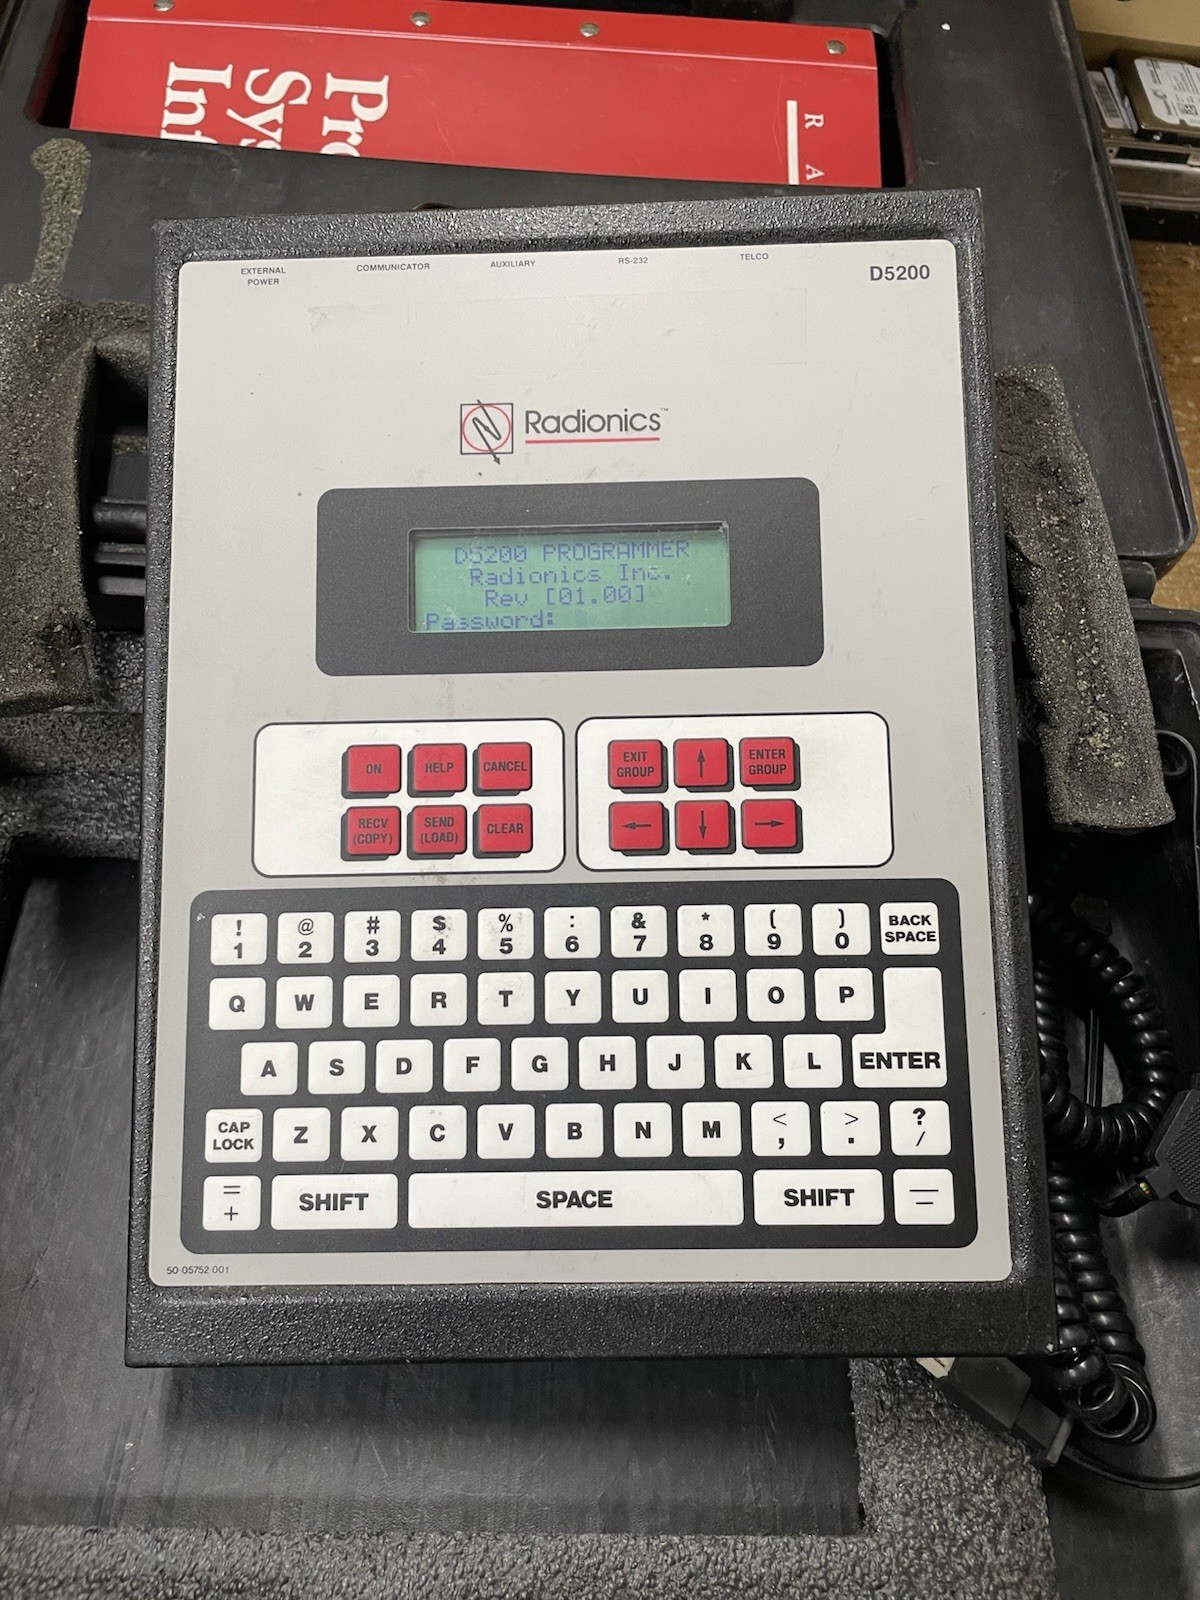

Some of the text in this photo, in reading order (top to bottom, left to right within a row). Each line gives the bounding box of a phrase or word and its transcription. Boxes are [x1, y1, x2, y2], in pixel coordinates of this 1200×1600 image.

[241, 267, 286, 275] EXTERNAL
[357, 263, 429, 271] COMMUNICATOR
[870, 265, 929, 280] D5200
[526, 409, 661, 434] Radionics
[455, 539, 690, 564] D5200 PROGRAMMER
[470, 562, 671, 586] Radionics Inc.
[485, 585, 644, 607] Rev [01.00]
[425, 610, 553, 630] Password:
[624, 752, 647, 761] EXIT
[750, 749, 785, 759] ENTER
[366, 764, 381, 774] ON
[426, 762, 453, 772] HELP
[484, 761, 527, 771] CANCEL
[617, 766, 654, 777] GROUP
[749, 764, 786, 774] GROUP
[359, 818, 387, 828] RECV
[425, 817, 454, 827] SEND
[487, 823, 523, 833] CLEAR
[354, 833, 392, 844] (COPY)
[421, 832, 458, 843] (LOAD)
[237, 920, 241, 936] !
[298, 919, 313, 935] @
[367, 916, 379, 934] #
[433, 916, 446, 932] $
[499, 914, 513, 932] %
[632, 913, 646, 929] &
[889, 915, 931, 925] BACK
[566, 936, 579, 952] 6
[634, 935, 646, 951] 7
[700, 934, 713, 950] 8
[768, 933, 781, 949] 9
[885, 931, 936, 942] SPACE
[234, 943, 242, 958] 1
[299, 942, 312, 958] 2
[366, 940, 379, 956] 3
[433, 939, 446, 954] 4
[500, 938, 513, 954] 5
[295, 994, 314, 1011] W
[365, 993, 378, 1010] E
[432, 992, 446, 1008] R
[499, 991, 513, 1007] T
[566, 990, 580, 1006] Y
[633, 988, 648, 1005] U
[705, 988, 710, 1004] I
[768, 987, 784, 1004] O
[839, 987, 854, 1003] P
[229, 995, 245, 1012] Q
[261, 1060, 277, 1077] A
[330, 1059, 344, 1076] S
[396, 1058, 412, 1075] D
[466, 1057, 479, 1073] F
[532, 1055, 547, 1073] G
[600, 1055, 615, 1071] H
[668, 1054, 680, 1071] J
[736, 1053, 752, 1070] K
[808, 1053, 821, 1069] L
[860, 1052, 940, 1069] ENTER
[913, 1108, 925, 1125] ?
[218, 1122, 250, 1133] CAP
[294, 1127, 308, 1143] Z
[361, 1126, 377, 1142] X
[430, 1124, 445, 1142] C
[499, 1123, 513, 1140] V
[568, 1123, 582, 1139] B
[636, 1122, 651, 1138] N
[703, 1121, 720, 1138] M
[213, 1139, 254, 1150] LOCK
[299, 1193, 369, 1211] SHIFT
[537, 1190, 612, 1208] SPACE
[784, 1189, 854, 1206] SHIFT
